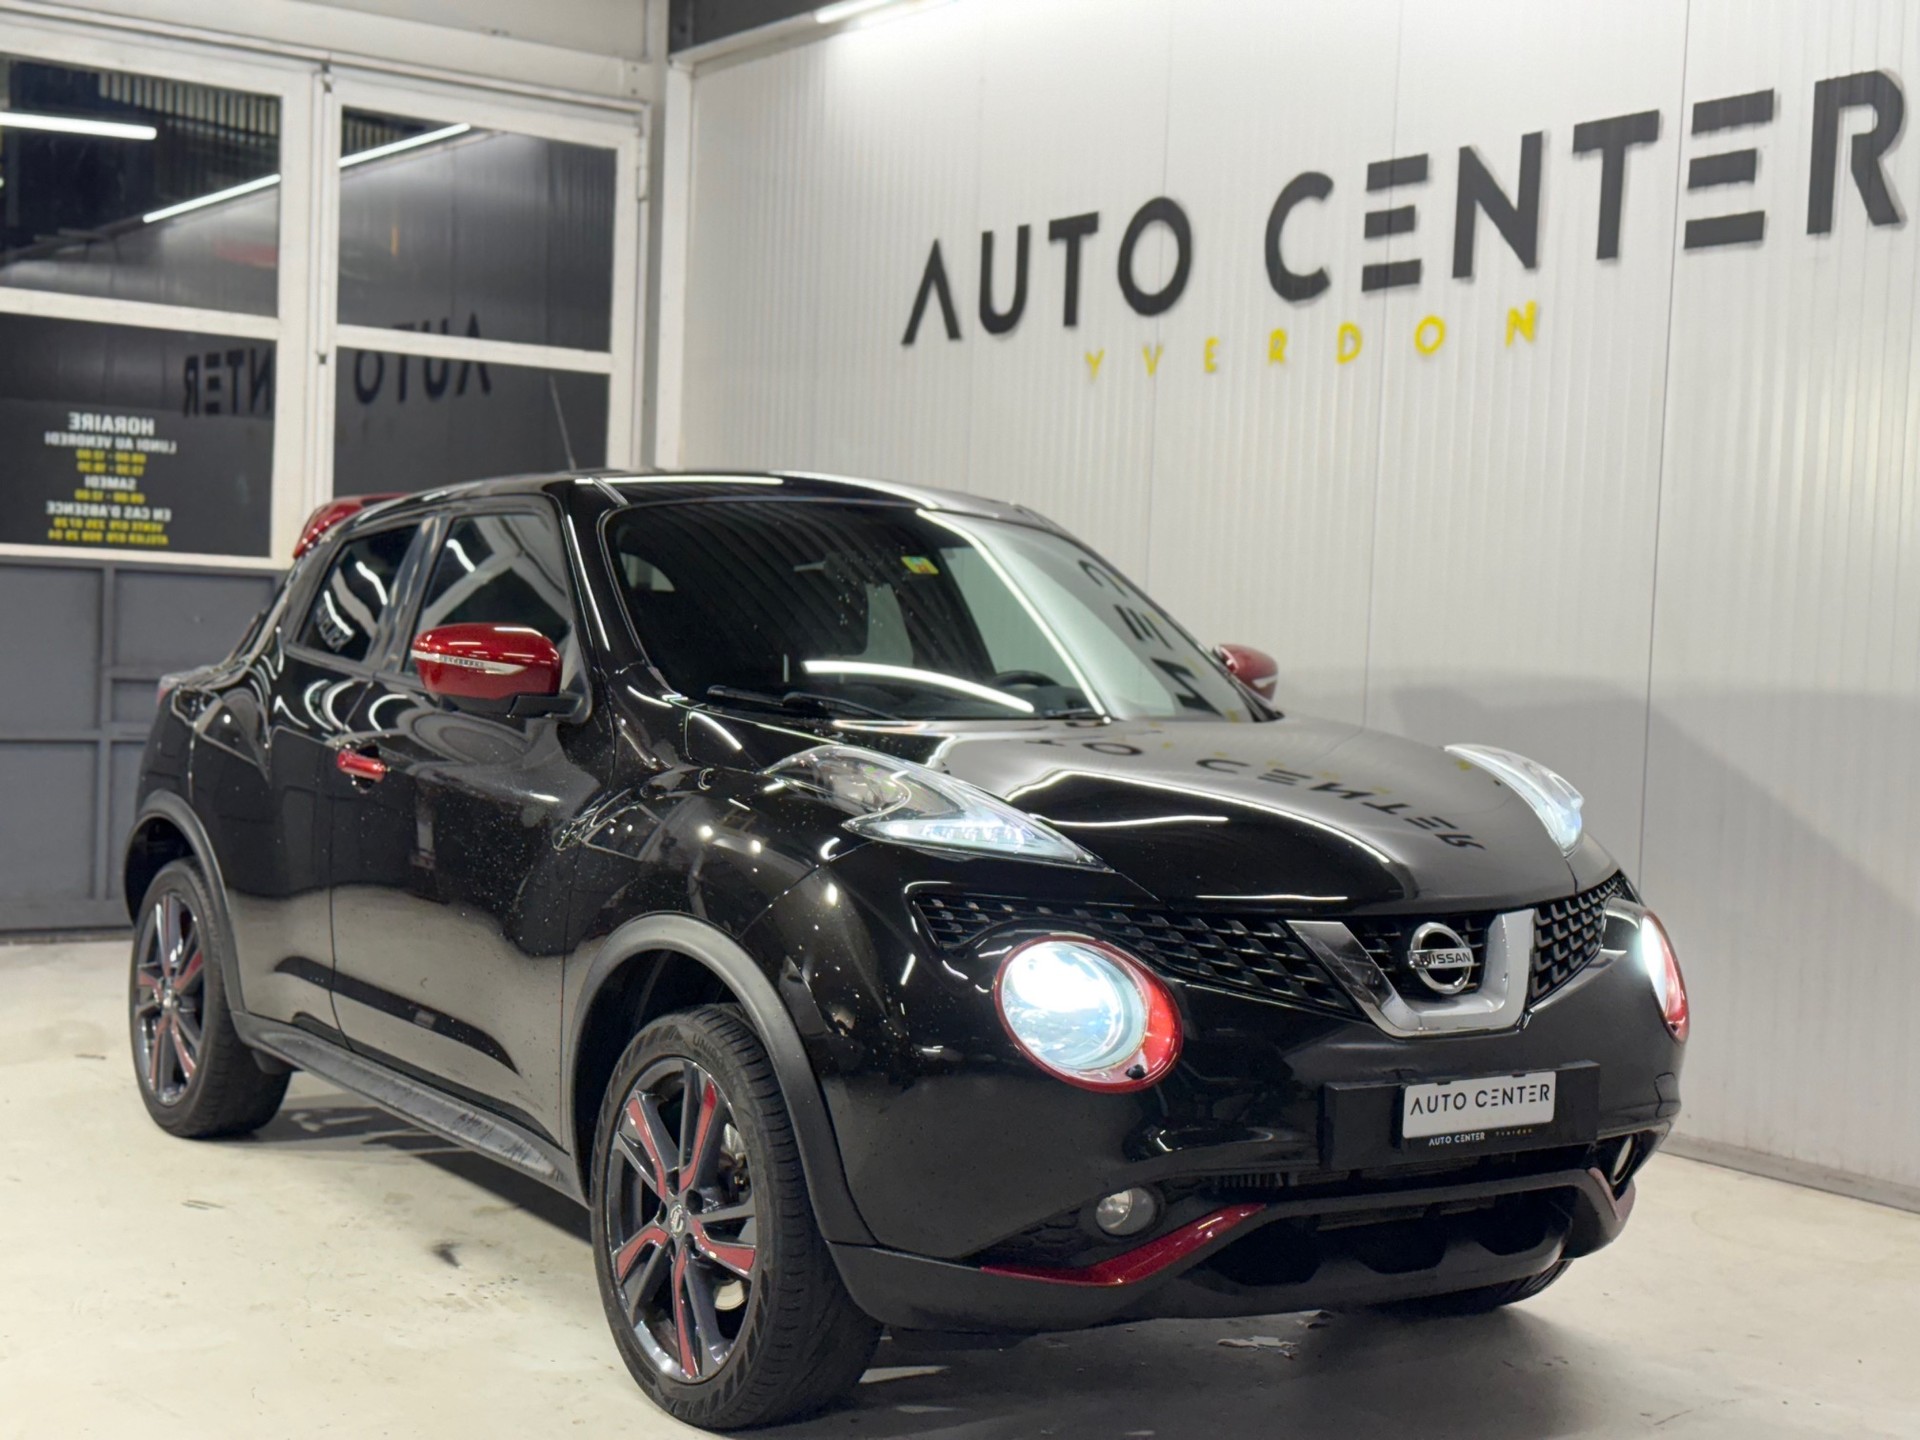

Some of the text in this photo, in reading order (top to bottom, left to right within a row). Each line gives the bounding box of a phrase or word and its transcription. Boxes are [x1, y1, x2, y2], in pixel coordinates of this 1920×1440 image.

[902, 70, 1906, 346] AUTO CENTER
[1085, 300, 1539, 380] YVERDON
[1420, 952, 1472, 966] NISSAN
[1410, 1083, 1550, 1116] AUTO CENTER
[1428, 1136, 1452, 1147] AUTO
[1454, 1132, 1486, 1143] CENTER
